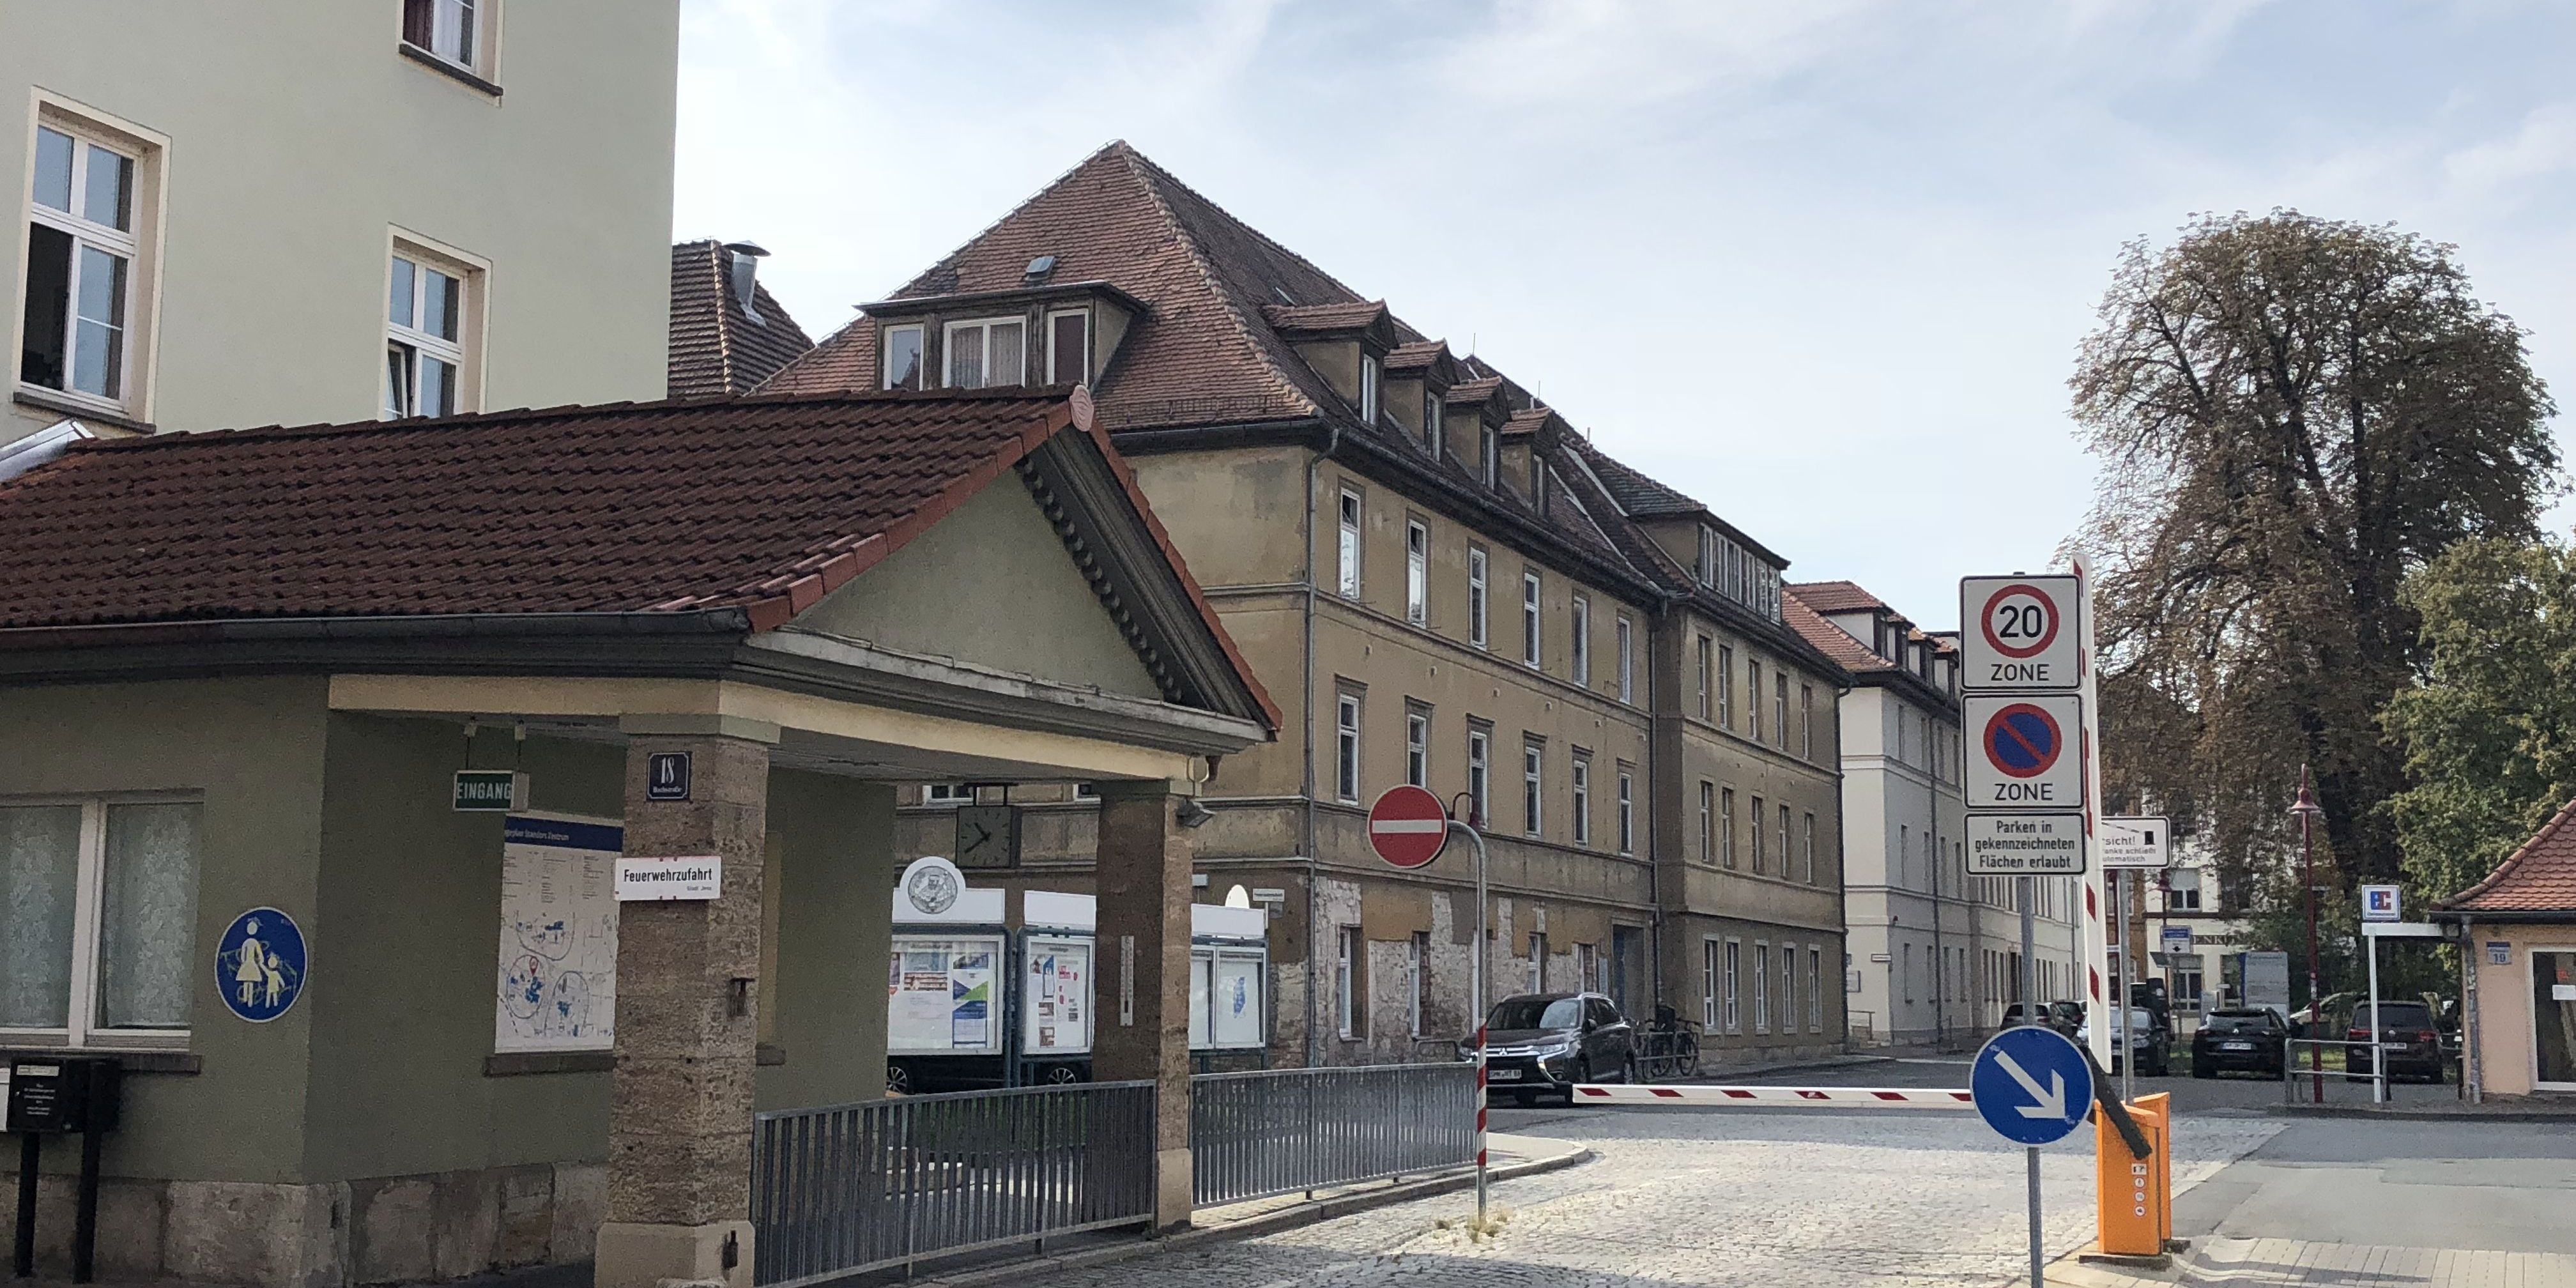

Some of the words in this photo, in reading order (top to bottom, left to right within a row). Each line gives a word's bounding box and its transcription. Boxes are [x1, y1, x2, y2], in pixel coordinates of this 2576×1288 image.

[2000, 605, 2042, 638] 20
[1991, 664, 2050, 681] ZONE
[661, 756, 674, 783] 18
[457, 783, 512, 799] EINGANG
[1994, 783, 2053, 801] ZONE
[1997, 820, 2036, 833] Parken
[2041, 820, 2052, 833] in
[1975, 837, 2075, 853] gekennzeichneten
[1980, 855, 2023, 868] Flächen
[2029, 855, 2071, 868] erlaubt
[624, 868, 712, 882] Feuerwehrzufahrt
